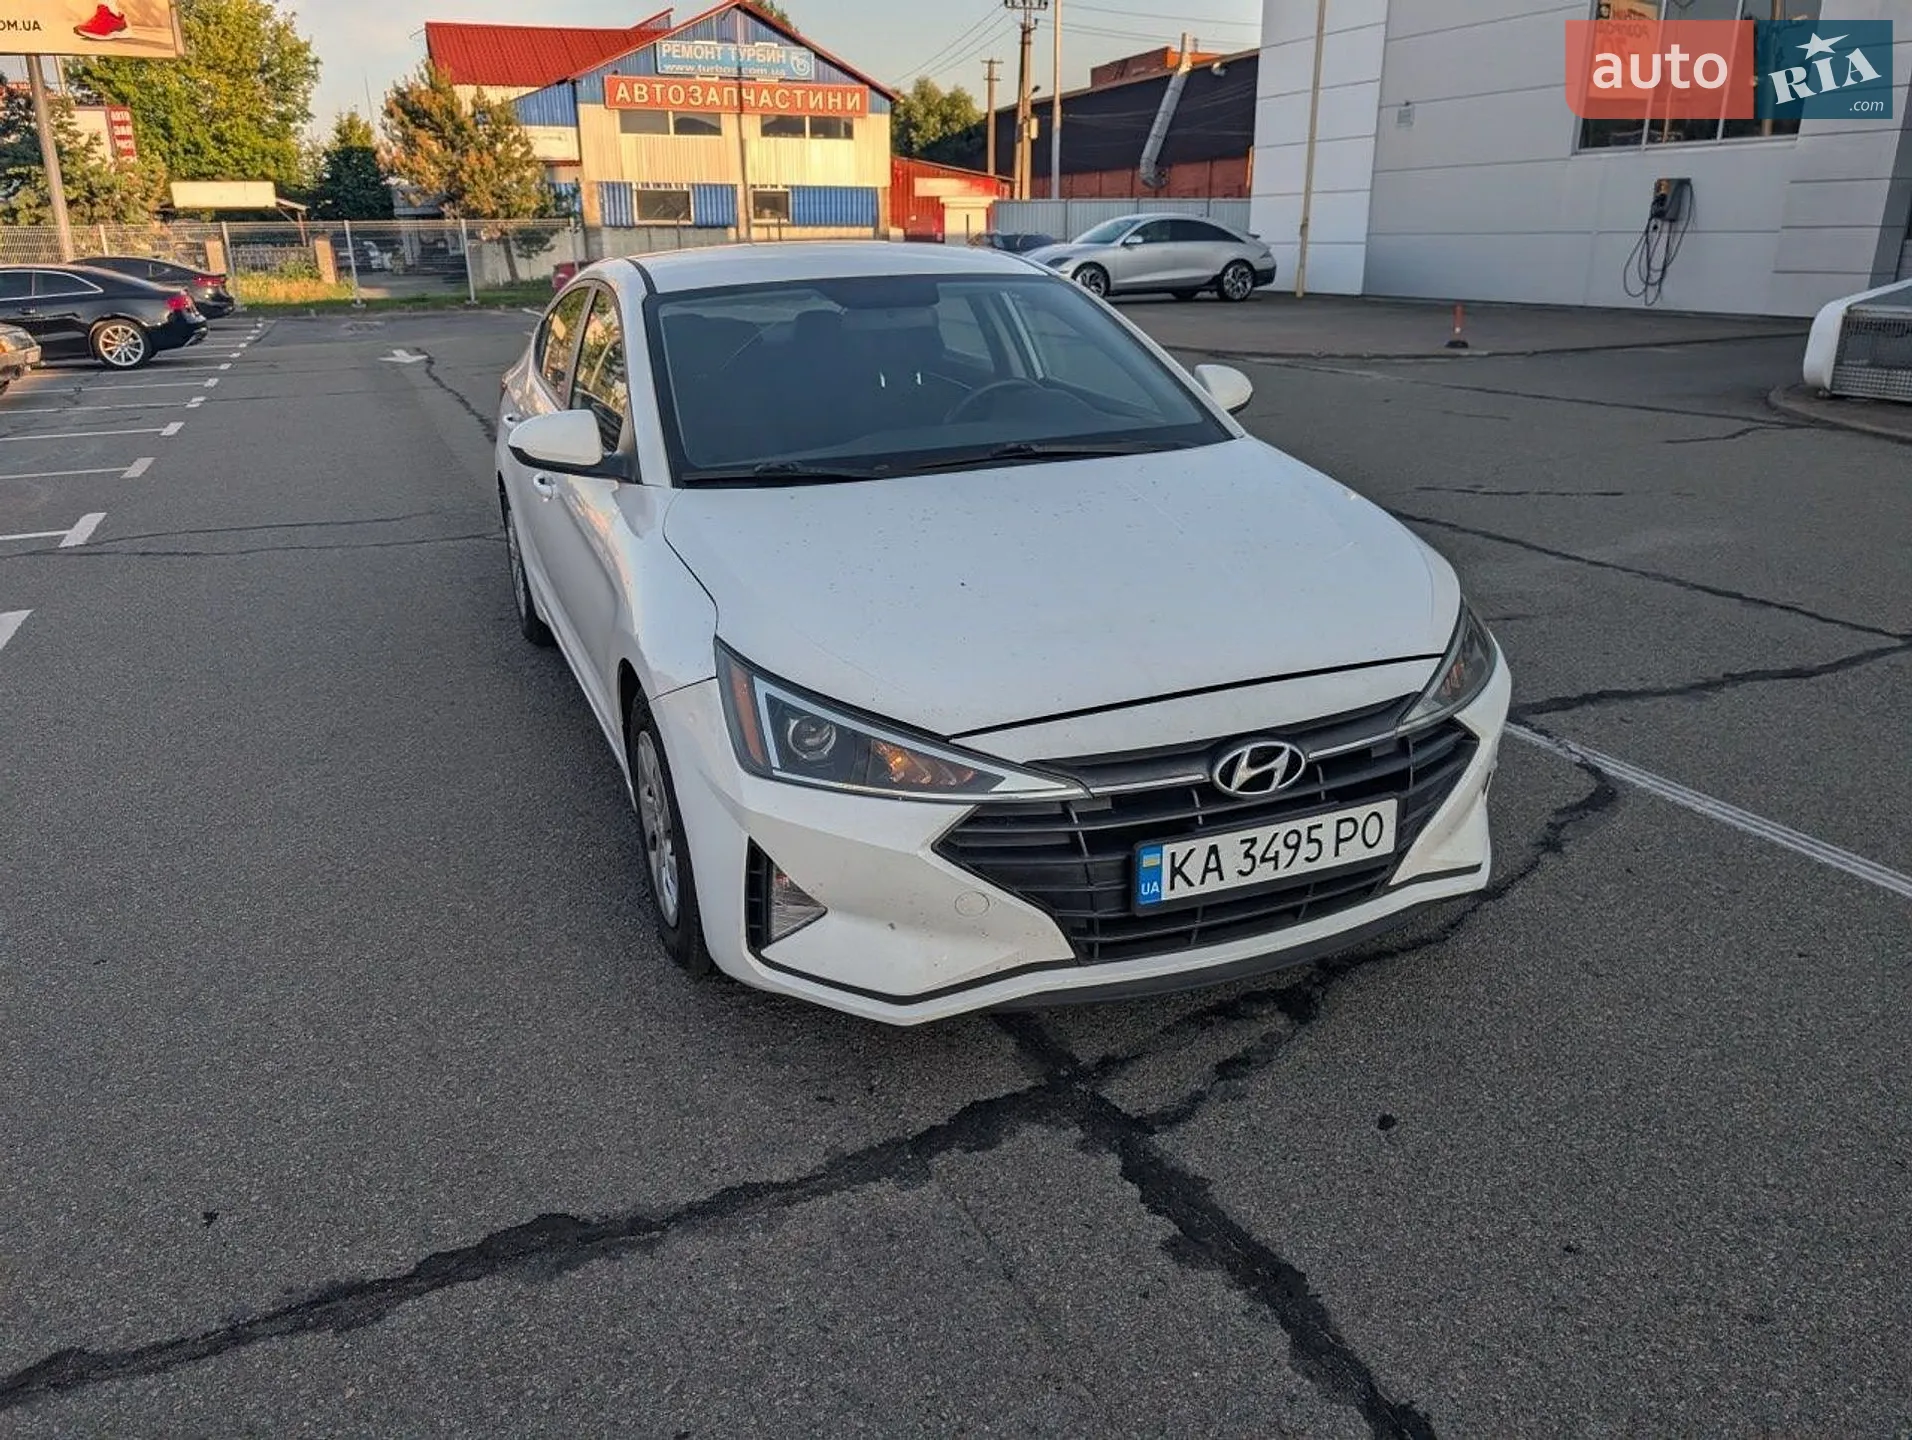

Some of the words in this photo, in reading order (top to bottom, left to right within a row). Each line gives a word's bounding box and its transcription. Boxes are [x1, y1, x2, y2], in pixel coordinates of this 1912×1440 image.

[661, 43, 722, 60] РЕМОНТ
[729, 46, 787, 65] ТУРБИН
[614, 82, 862, 112] АВТОЗАПЧАСТИНИ
[1168, 843, 1225, 891] KA
[1236, 823, 1323, 877] 3495
[1333, 811, 1384, 858] PO
[1140, 881, 1160, 896] UA
